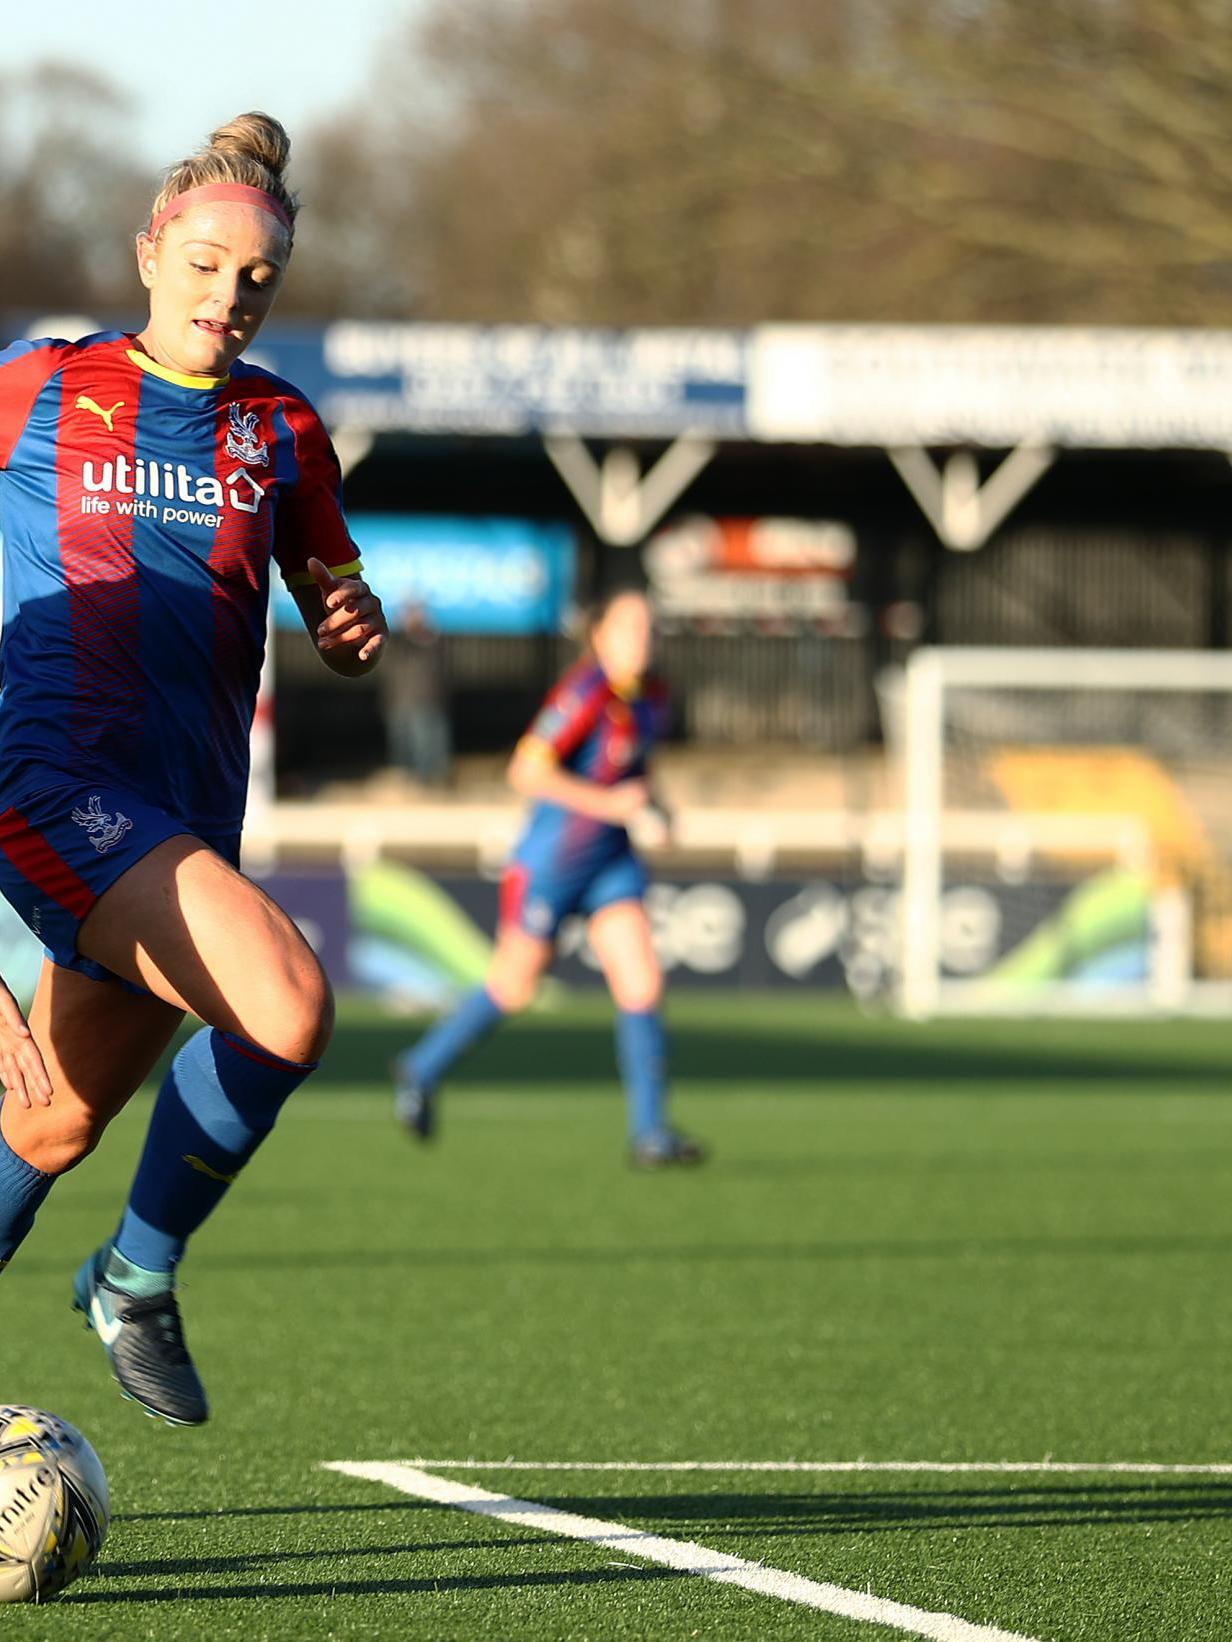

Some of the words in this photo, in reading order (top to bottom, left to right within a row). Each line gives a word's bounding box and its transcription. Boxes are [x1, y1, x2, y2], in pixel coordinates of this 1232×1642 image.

[82, 454, 224, 507] utilita
[81, 496, 111, 514] life
[116, 498, 158, 519] with
[162, 505, 224, 528] power
